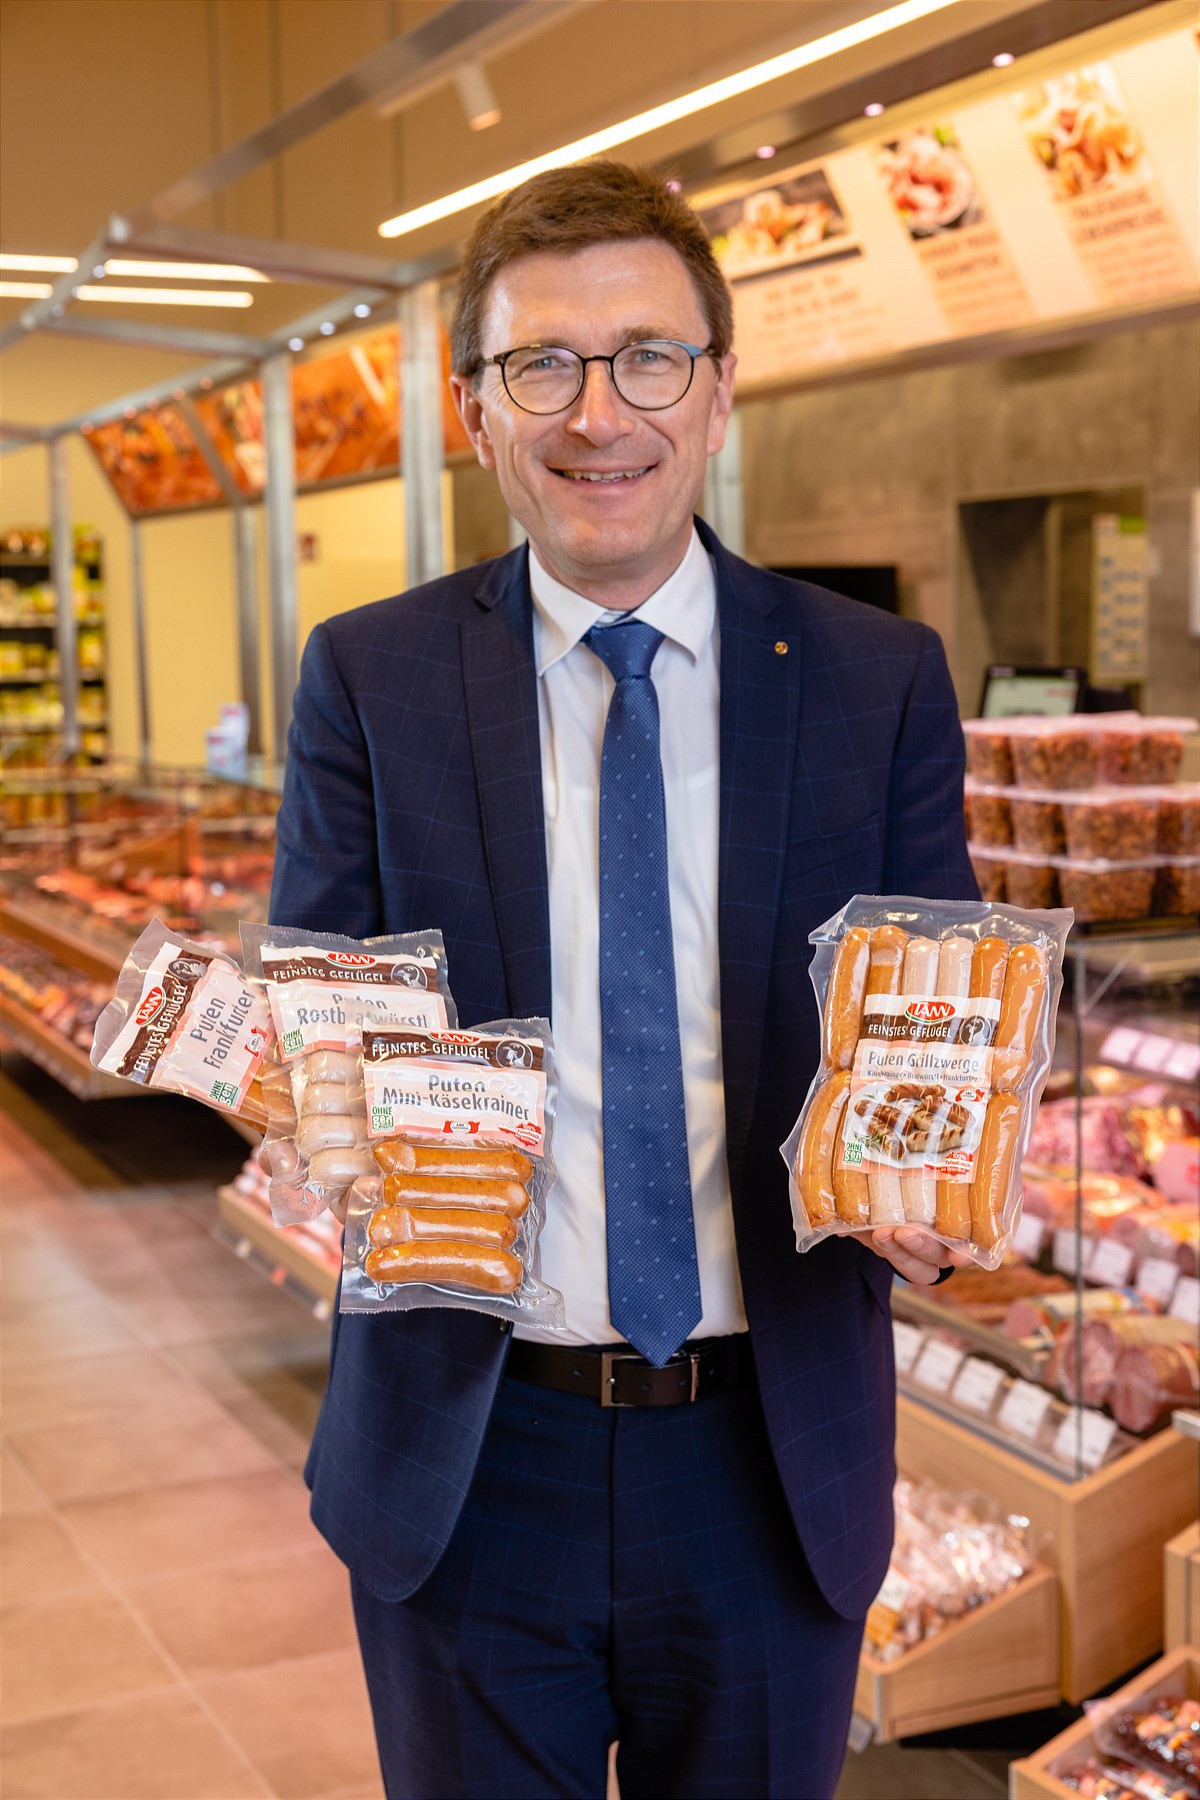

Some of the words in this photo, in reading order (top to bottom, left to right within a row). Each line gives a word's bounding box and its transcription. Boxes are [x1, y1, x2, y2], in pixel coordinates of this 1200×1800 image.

[335, 953, 371, 966] TANN
[273, 966, 325, 980] FEINSTES
[330, 970, 386, 983] GEFLÜGEL
[158, 984, 189, 1033] GEFLÜGEL
[915, 1002, 951, 1017] TANN
[190, 997, 226, 1043] Puten
[203, 989, 256, 1070] Frankfurter
[868, 1024, 906, 1038] FEINSTES
[910, 1025, 952, 1039] GEFLÜGEL
[372, 1042, 426, 1057] FEINSTES
[432, 1043, 490, 1059] GEFLÜGEL
[868, 1051, 904, 1067] Puten
[908, 1053, 979, 1074] Grillzwerge
[209, 1080, 223, 1100] OHNE
[428, 1074, 486, 1092] Puten
[372, 1106, 392, 1115] OHNE
[383, 1087, 529, 1121] Mini-Käsekrainer
[846, 1142, 862, 1151] OHNE
